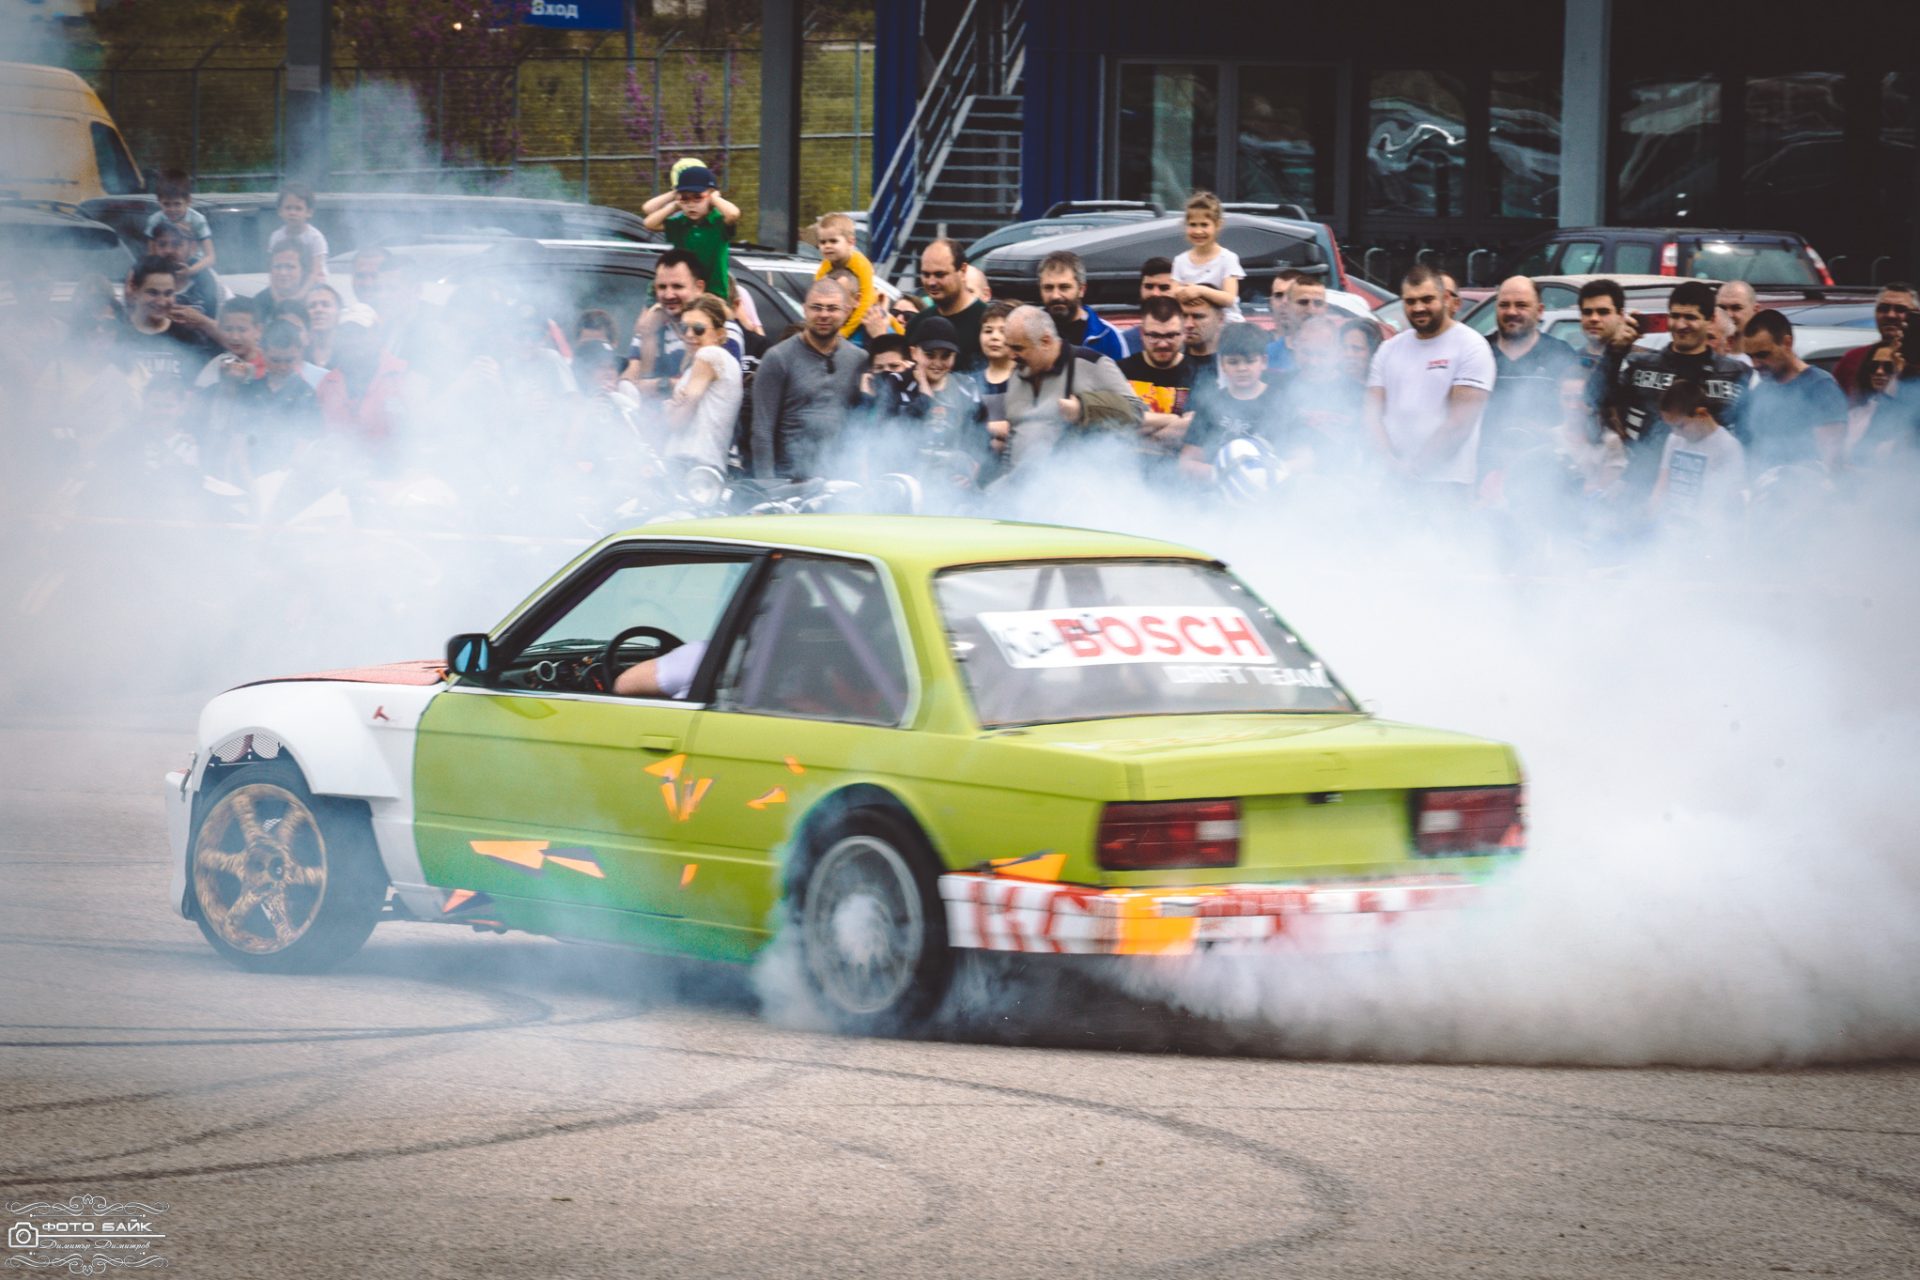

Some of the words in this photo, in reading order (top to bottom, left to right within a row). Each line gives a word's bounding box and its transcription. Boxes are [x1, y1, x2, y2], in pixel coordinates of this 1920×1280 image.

[531, 0, 579, 19] Вход
[1050, 615, 1271, 657] BOSCH
[1245, 667, 1333, 688] TEAM
